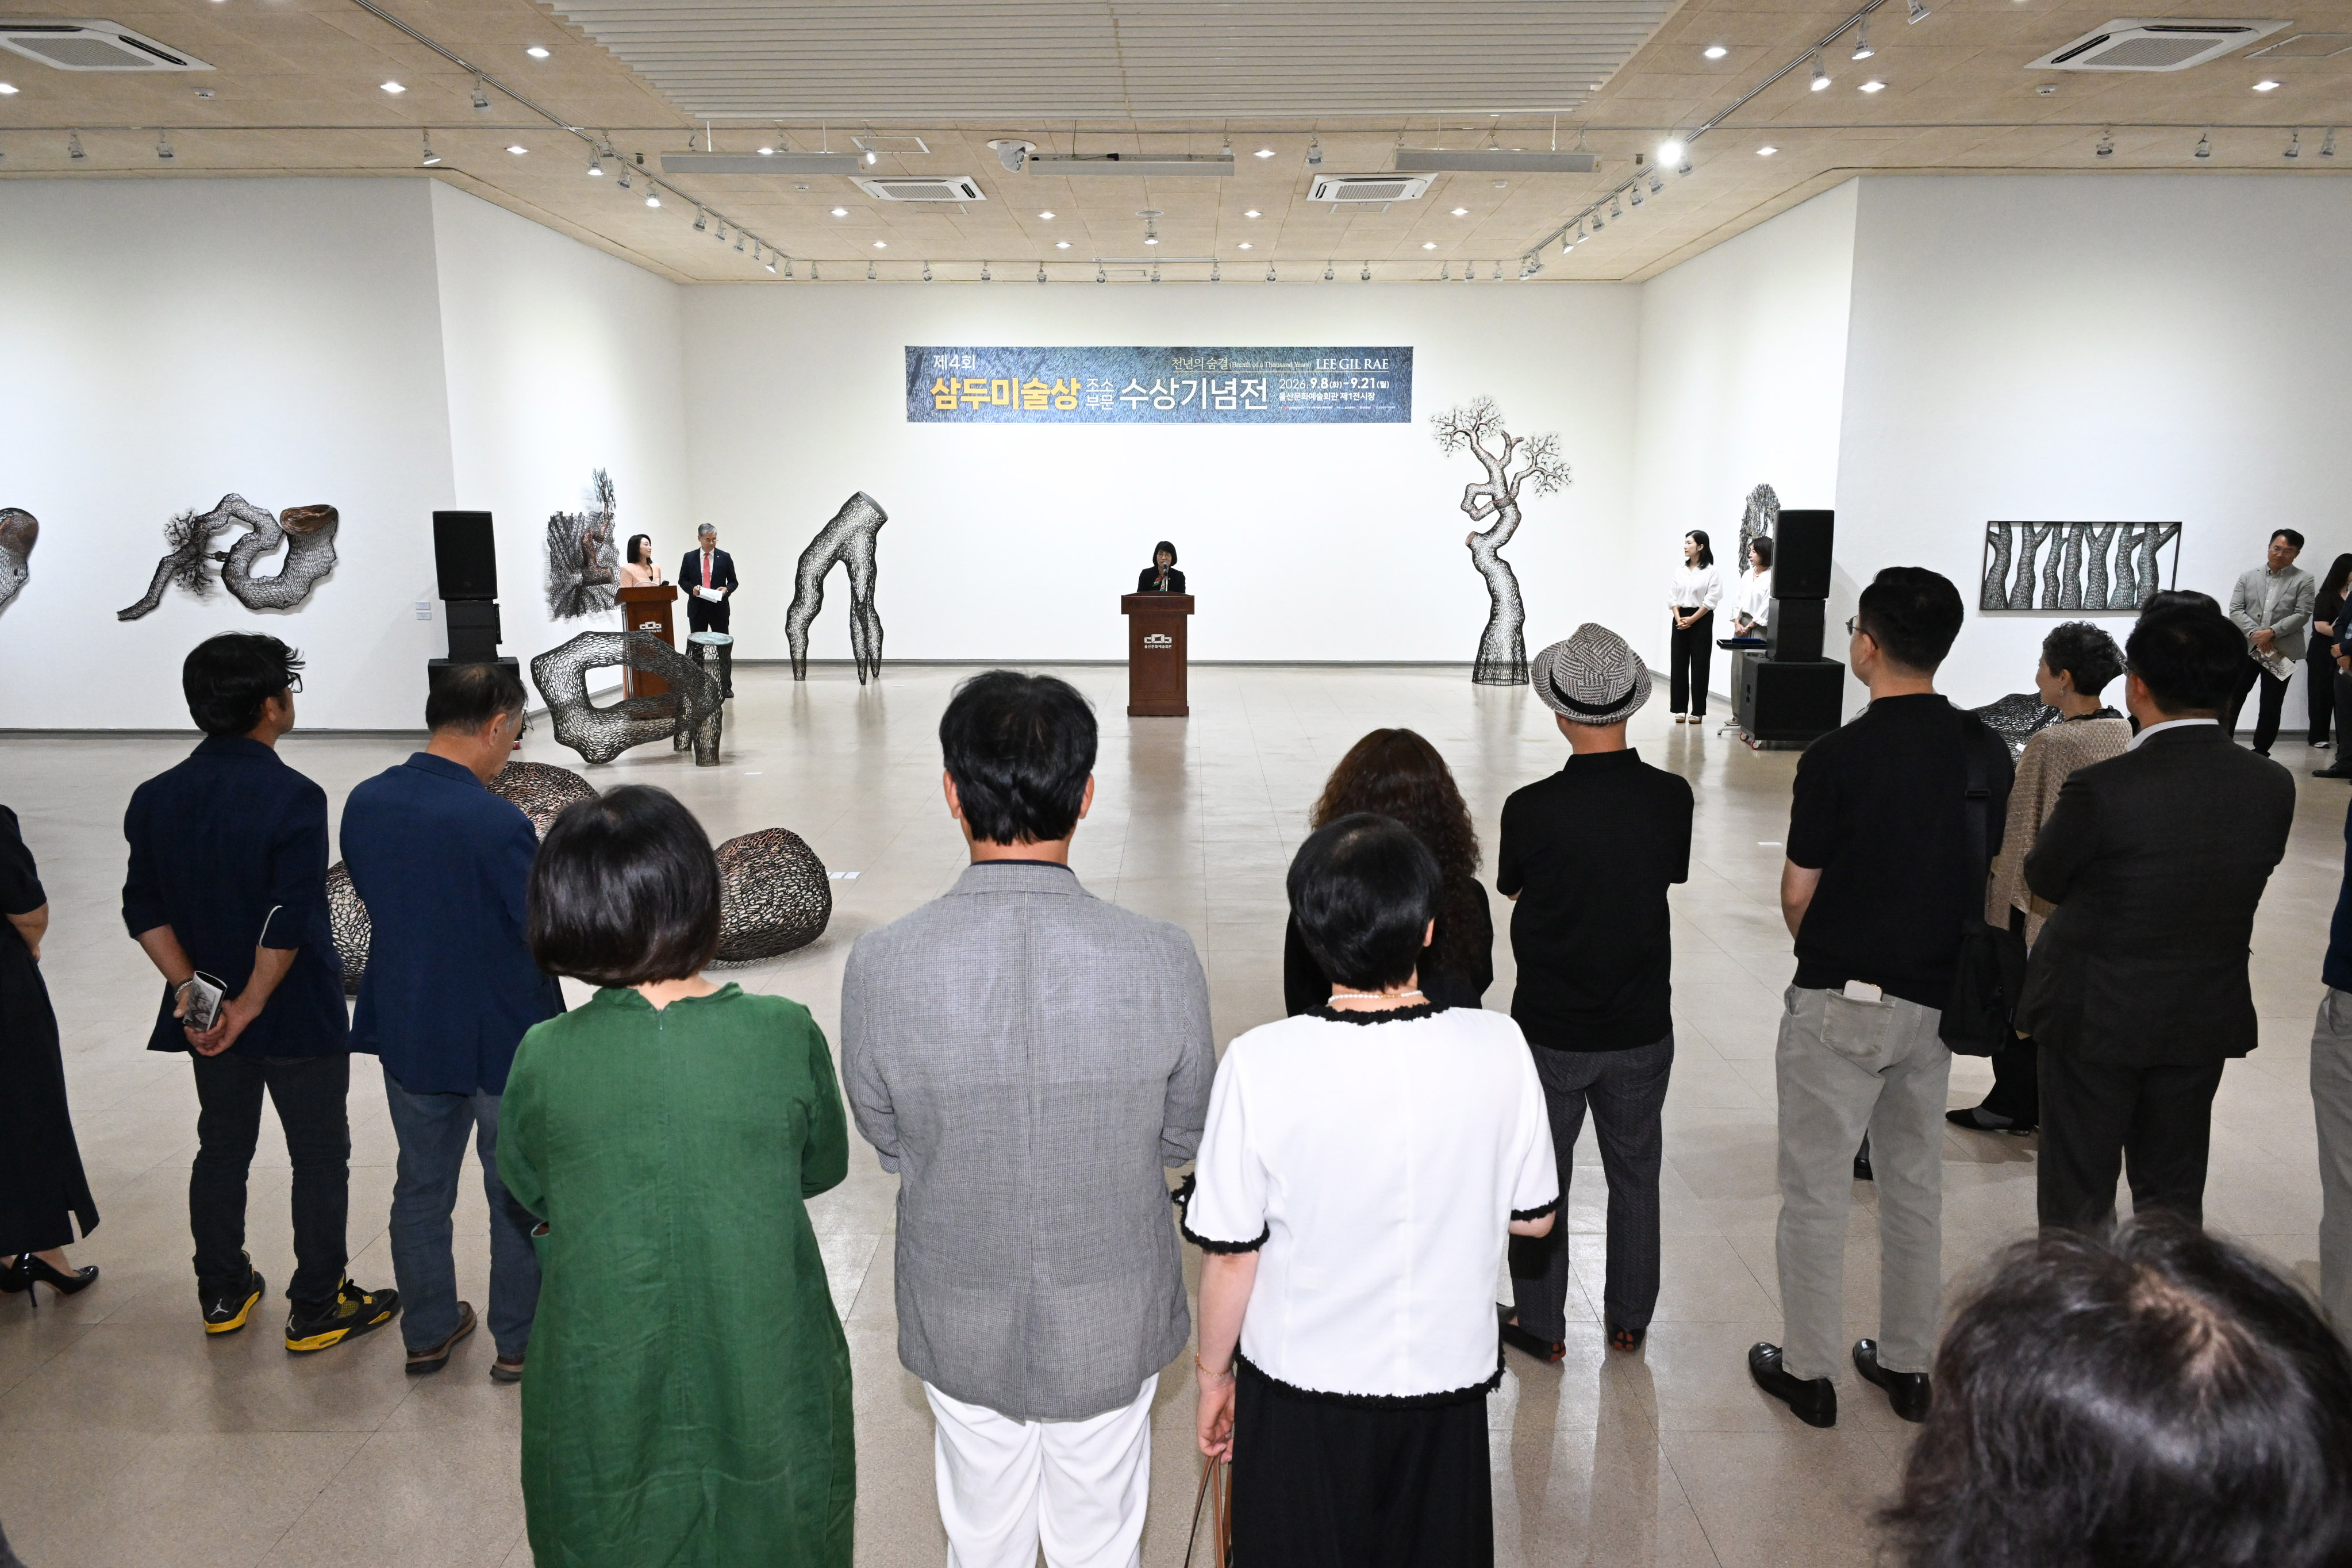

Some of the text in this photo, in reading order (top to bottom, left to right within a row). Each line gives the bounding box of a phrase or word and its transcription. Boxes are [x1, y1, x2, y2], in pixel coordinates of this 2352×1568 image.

[933, 354, 975, 370] 제4회
[1172, 357, 1228, 370] 천년의 숨결
[1316, 359, 1389, 370] LEE GIL RAE
[1086, 378, 1114, 393] 조소
[931, 377, 1081, 410] 삼두미술상
[1120, 378, 1267, 410] 수상기념전
[1279, 392, 1375, 401] 울산문화예술회관 제1전시장
[1086, 394, 1114, 410] 부문
